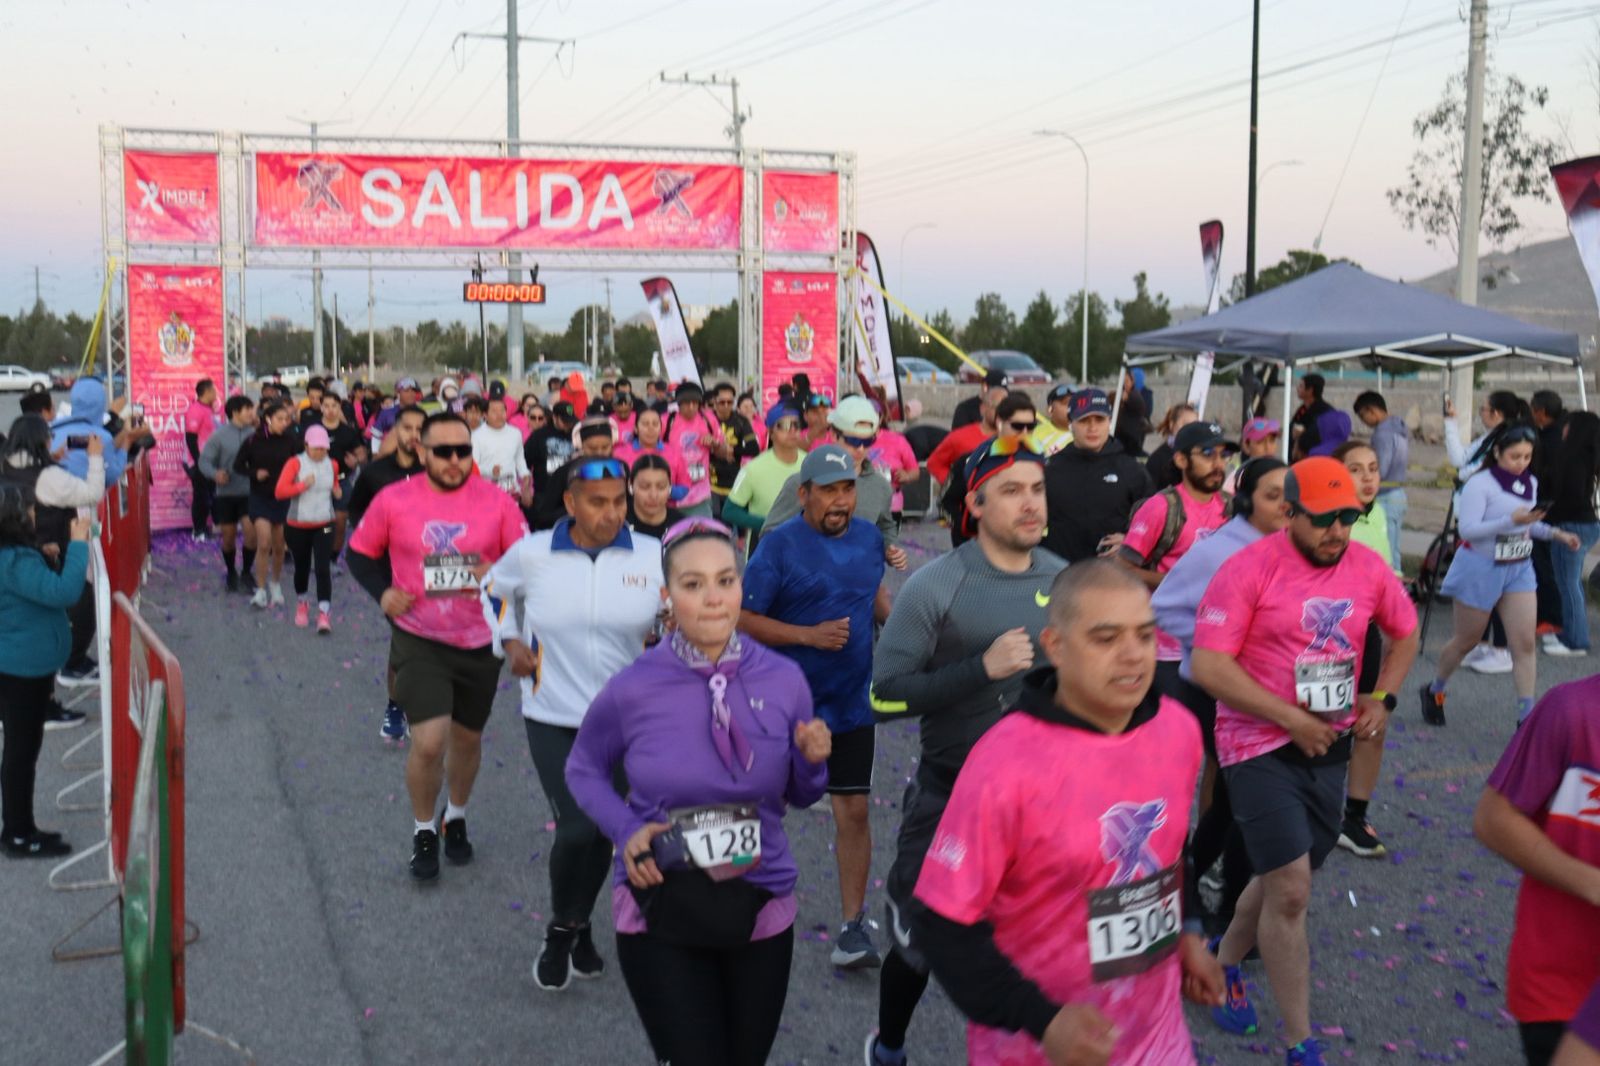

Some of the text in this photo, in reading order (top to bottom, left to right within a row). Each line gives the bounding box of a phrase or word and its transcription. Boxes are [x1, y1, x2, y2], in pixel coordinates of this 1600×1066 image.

[161, 188, 206, 207] IMDEJ
[360, 167, 635, 231] SALIDA
[700, 824, 757, 861] 128
[1097, 897, 1177, 956] 1306
